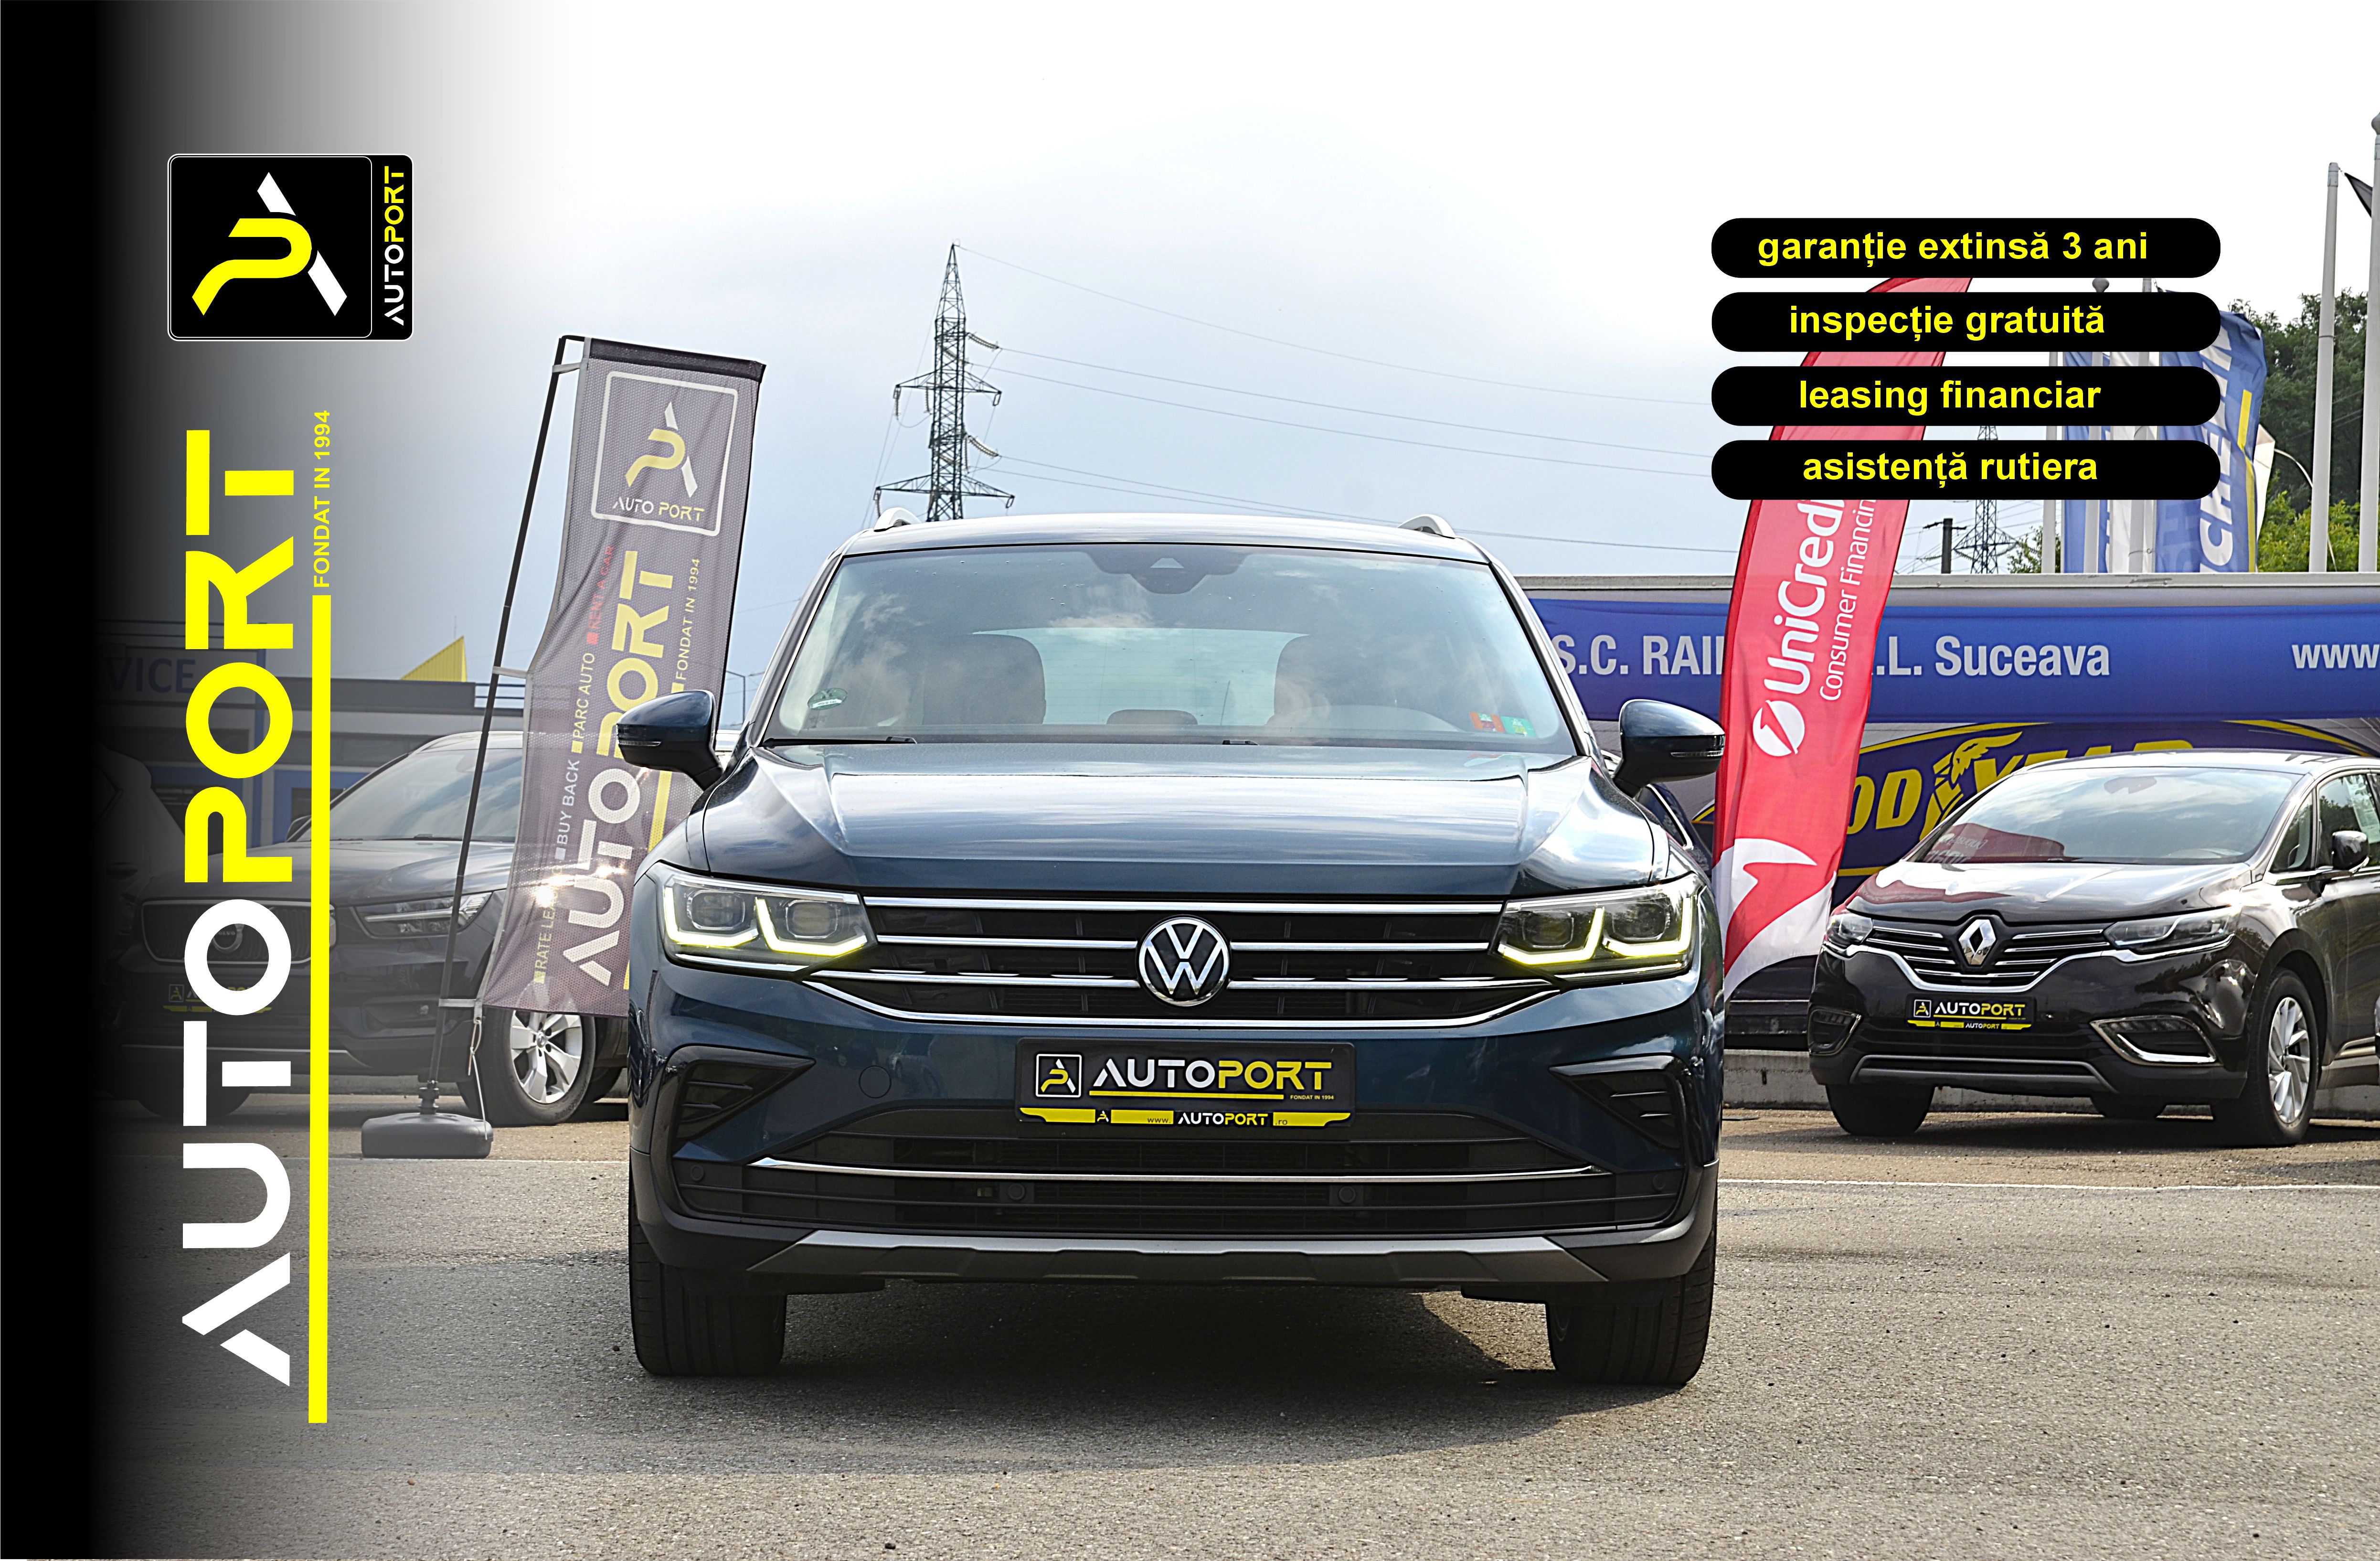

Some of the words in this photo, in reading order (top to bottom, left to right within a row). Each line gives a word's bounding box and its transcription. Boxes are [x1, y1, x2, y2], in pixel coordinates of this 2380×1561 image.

[613, 496, 654, 514] AUTO
[659, 502, 705, 522] PORT
[596, 579, 606, 589] A
[688, 558, 701, 591] 1994
[590, 594, 604, 630] RENT
[686, 597, 695, 613] IN
[1764, 500, 1845, 694] UniCredi
[1820, 590, 1857, 701] Consumer
[1840, 500, 1876, 586] Financin
[676, 617, 693, 681] FONDAT
[1551, 634, 1628, 675] S.C.
[1935, 635, 2110, 676] Suceava
[578, 652, 595, 695] AUTO
[574, 698, 589, 739] PARC
[563, 760, 580, 808] BACK
[557, 812, 572, 845] BUY
[535, 933, 552, 969] RATE
[1934, 1002, 2026, 1016] AUTOPORT
[1094, 1058, 1332, 1090] AUTOPORT
[1178, 1112, 1268, 1125] AUTOPORT
